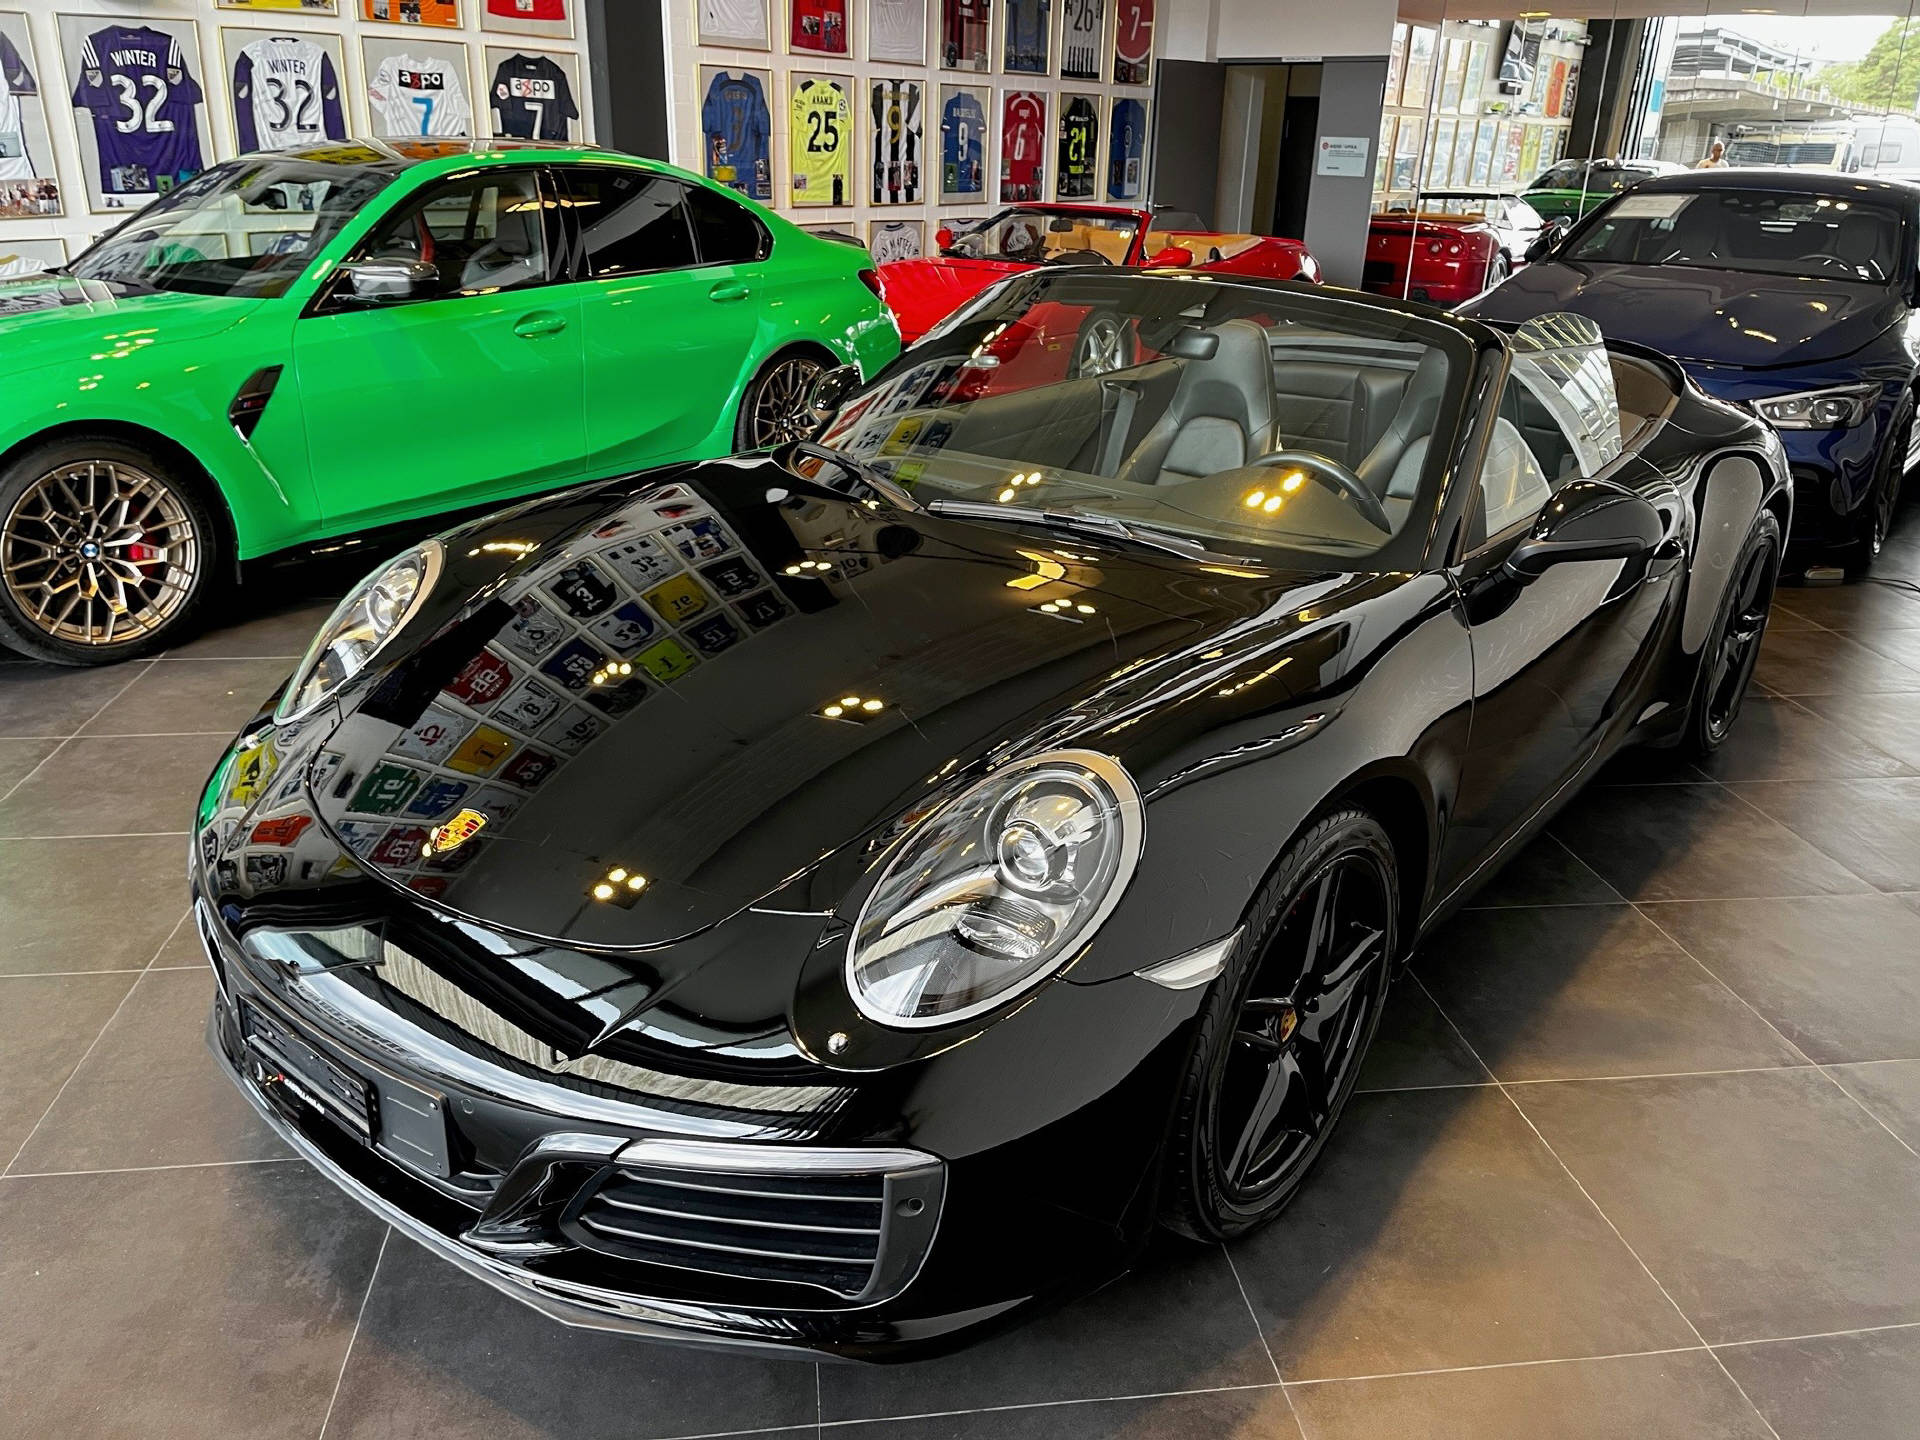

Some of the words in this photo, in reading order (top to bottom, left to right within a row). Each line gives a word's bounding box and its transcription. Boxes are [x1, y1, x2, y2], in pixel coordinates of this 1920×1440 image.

[110, 50, 157, 68] WINTER
[267, 59, 306, 76] WINTER
[110, 74, 175, 133] 32
[266, 78, 320, 133] 32
[412, 97, 434, 136] 7
[524, 102, 544, 140] 7
[807, 110, 839, 152] 25
[888, 105, 902, 144] 9
[958, 122, 969, 162] 9
[1014, 123, 1027, 161] 6
